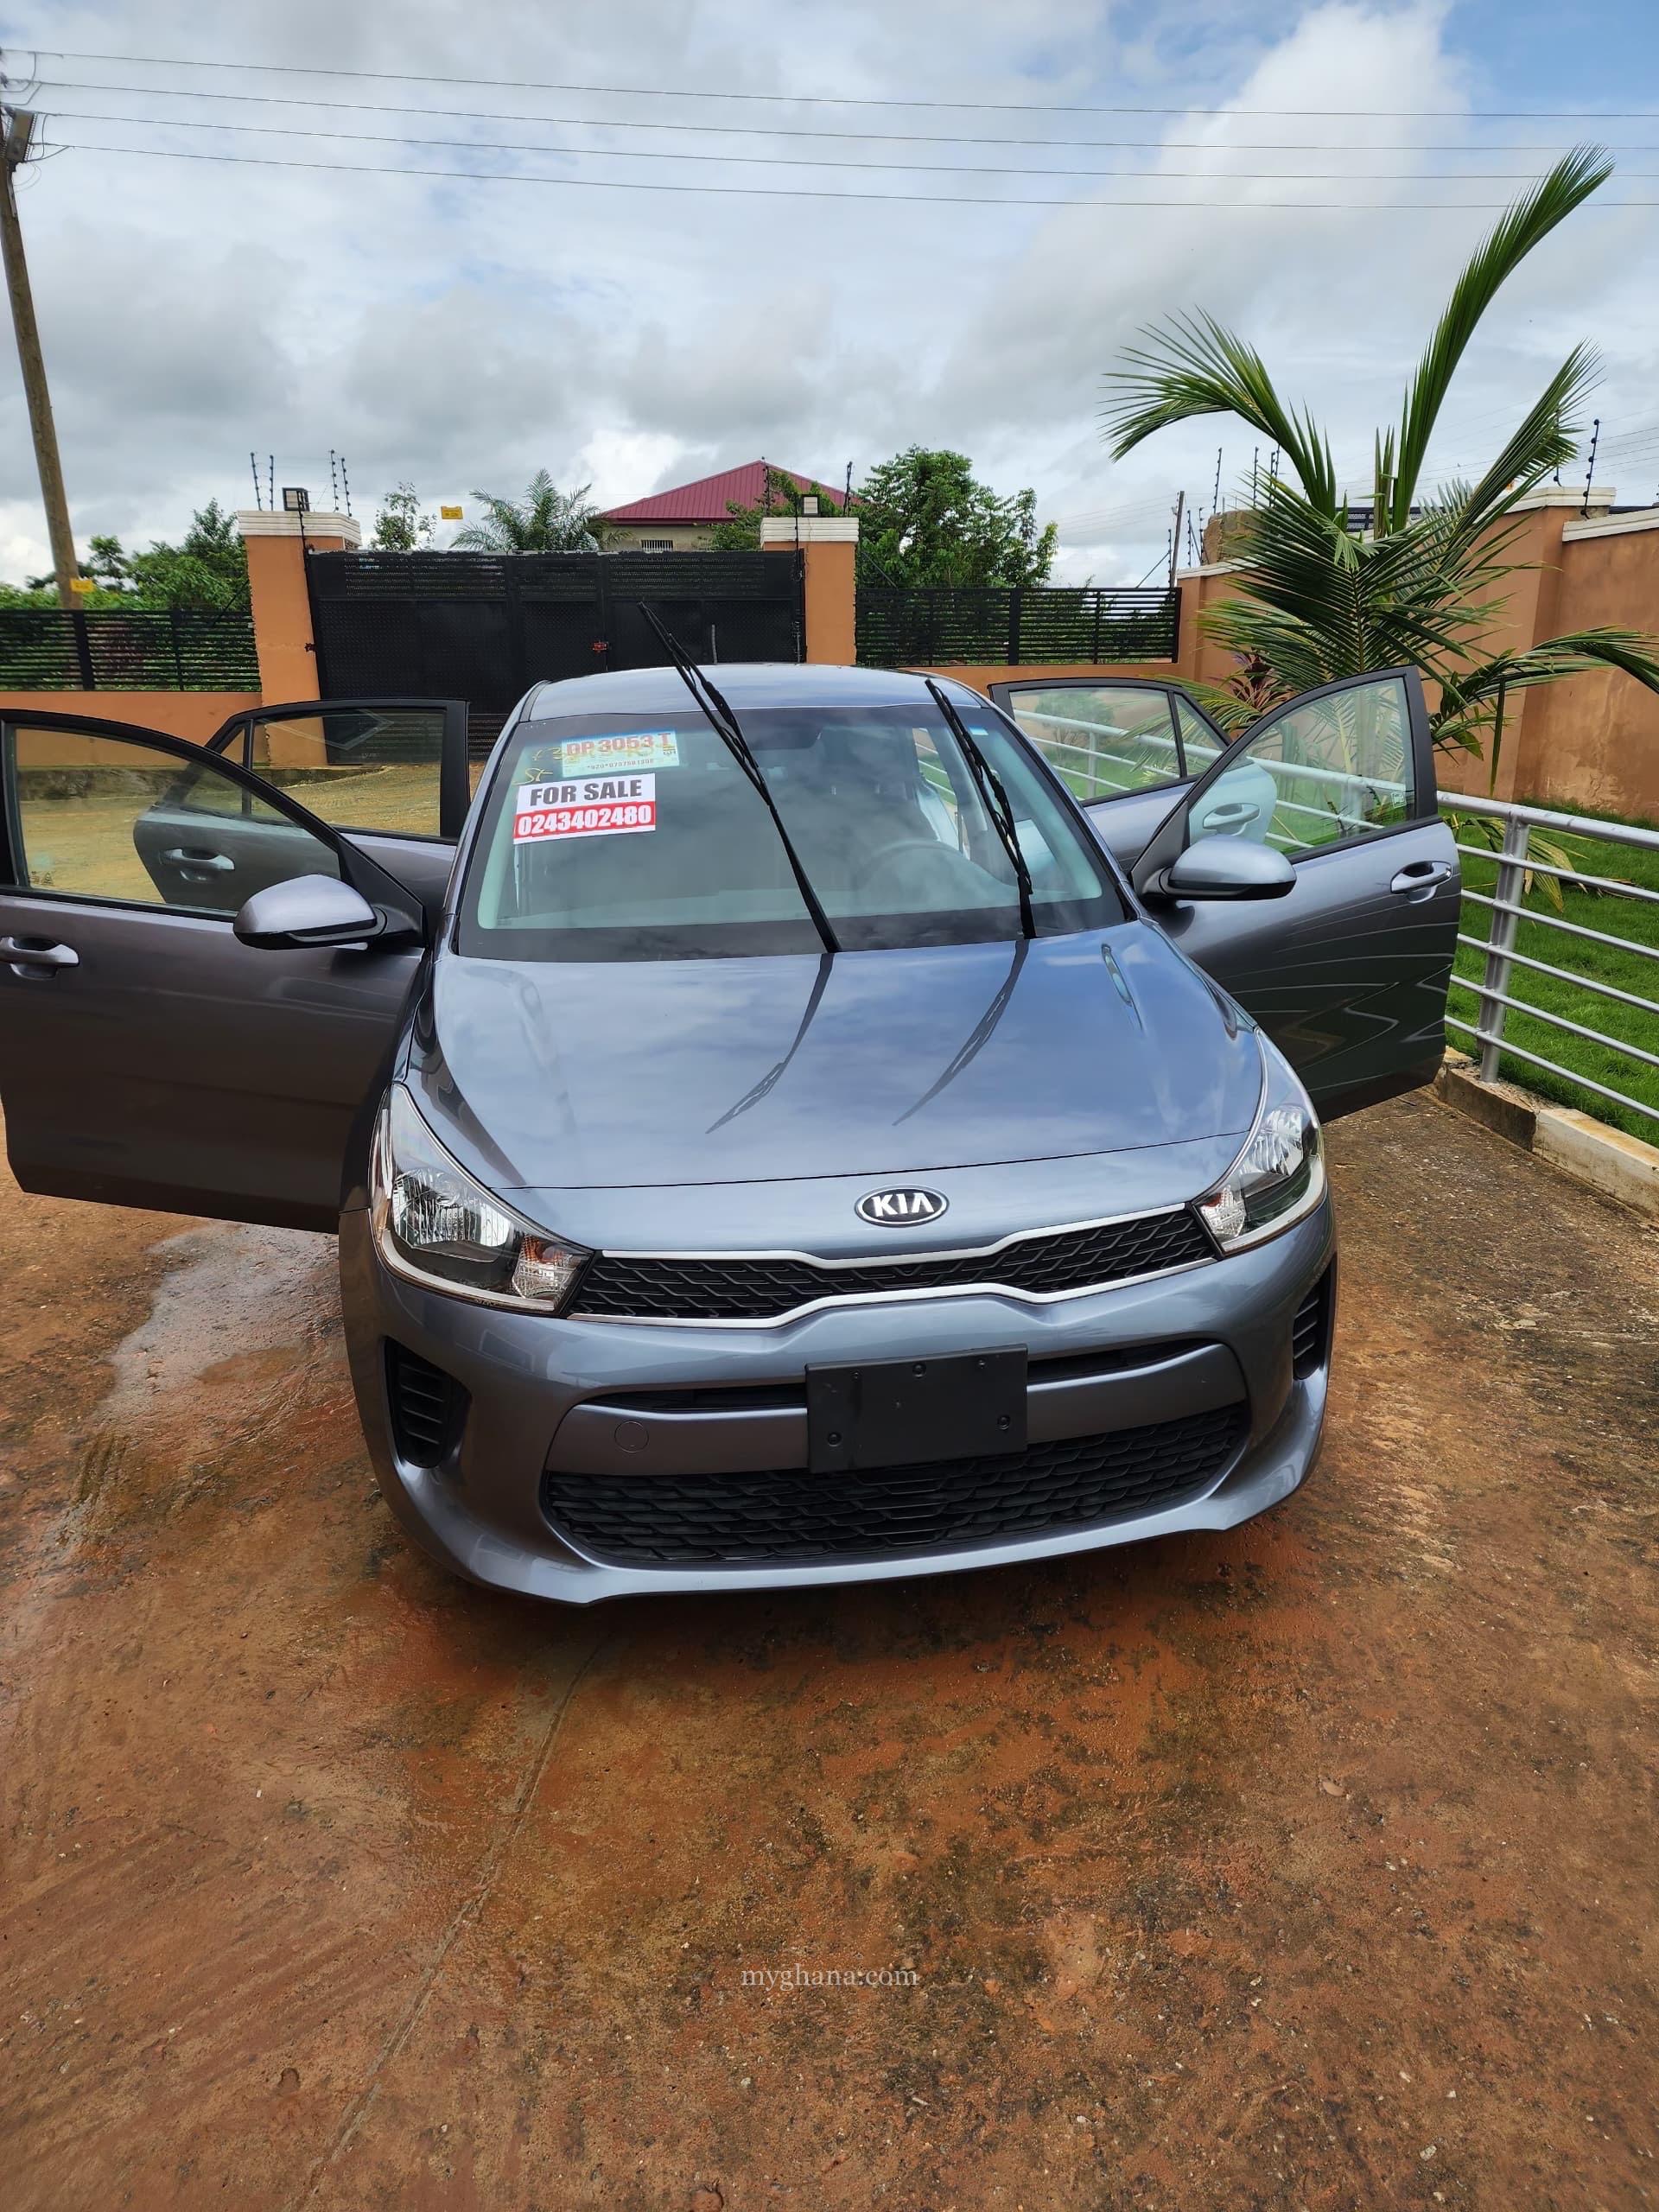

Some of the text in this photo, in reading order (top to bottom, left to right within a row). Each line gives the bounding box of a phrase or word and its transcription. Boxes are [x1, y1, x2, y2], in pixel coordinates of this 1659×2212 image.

[597, 734, 654, 753] 3053
[530, 779, 642, 805] FOR SALE
[518, 804, 652, 836] 0243402480
[871, 1192, 935, 1217] KIA
